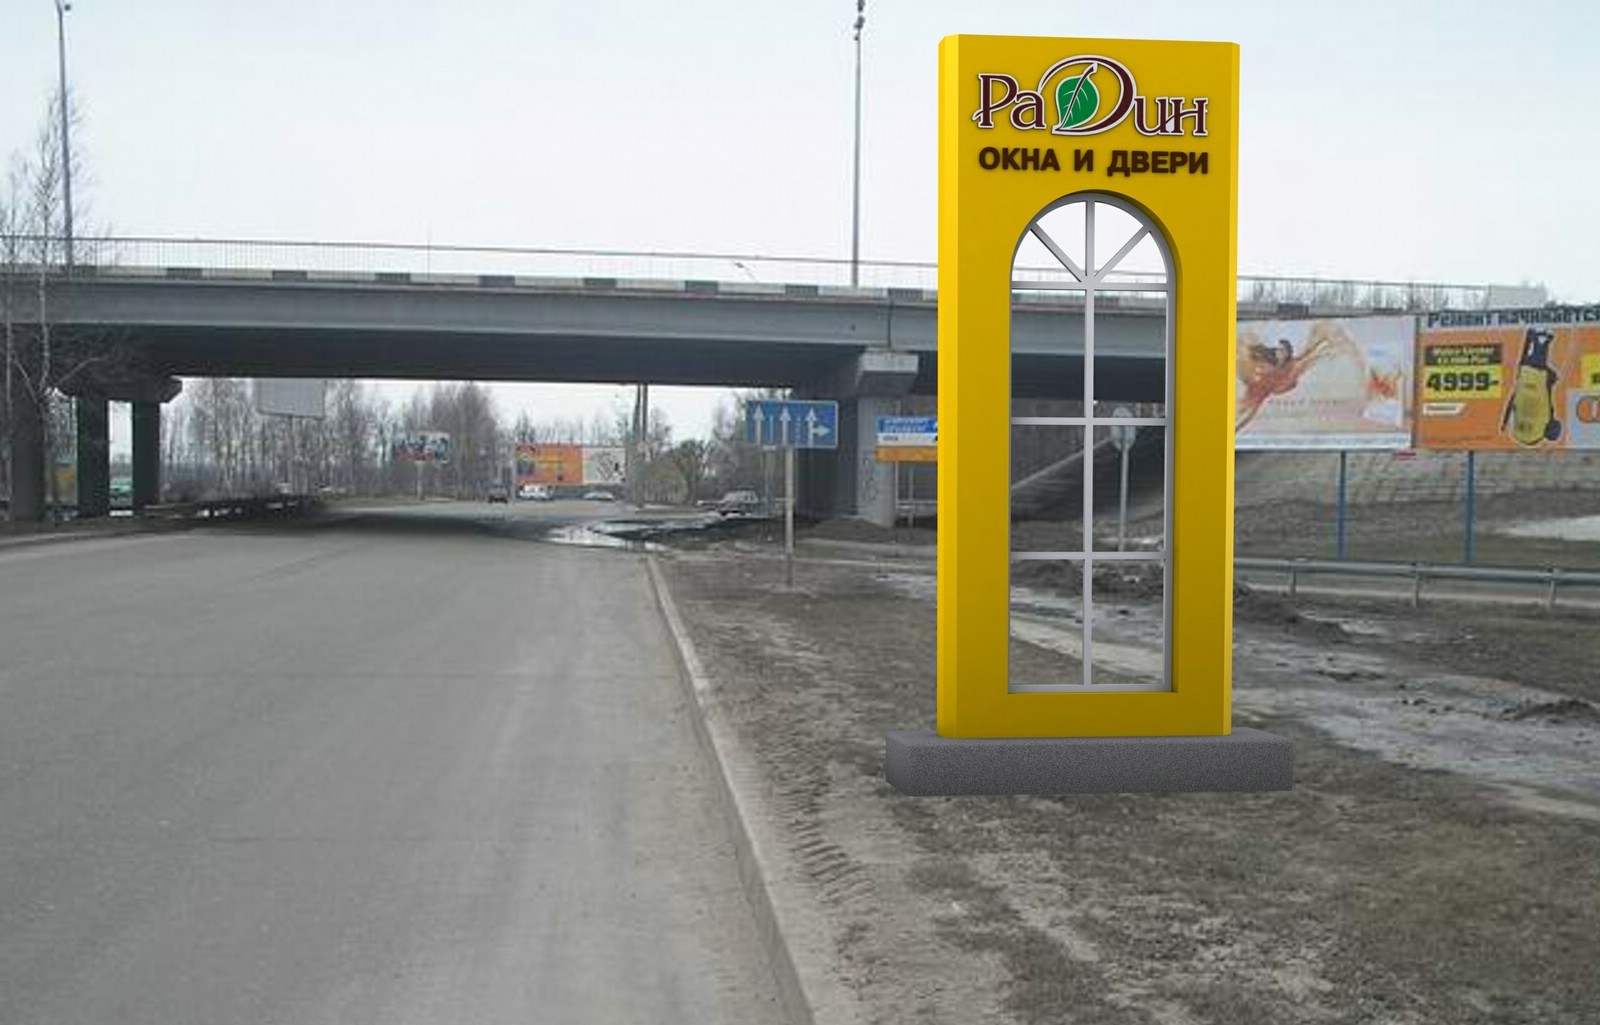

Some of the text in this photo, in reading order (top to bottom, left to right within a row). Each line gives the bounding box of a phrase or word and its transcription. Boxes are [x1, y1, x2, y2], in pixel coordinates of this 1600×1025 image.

[978, 147, 1208, 177] ОКНА И ДВЕРИ
